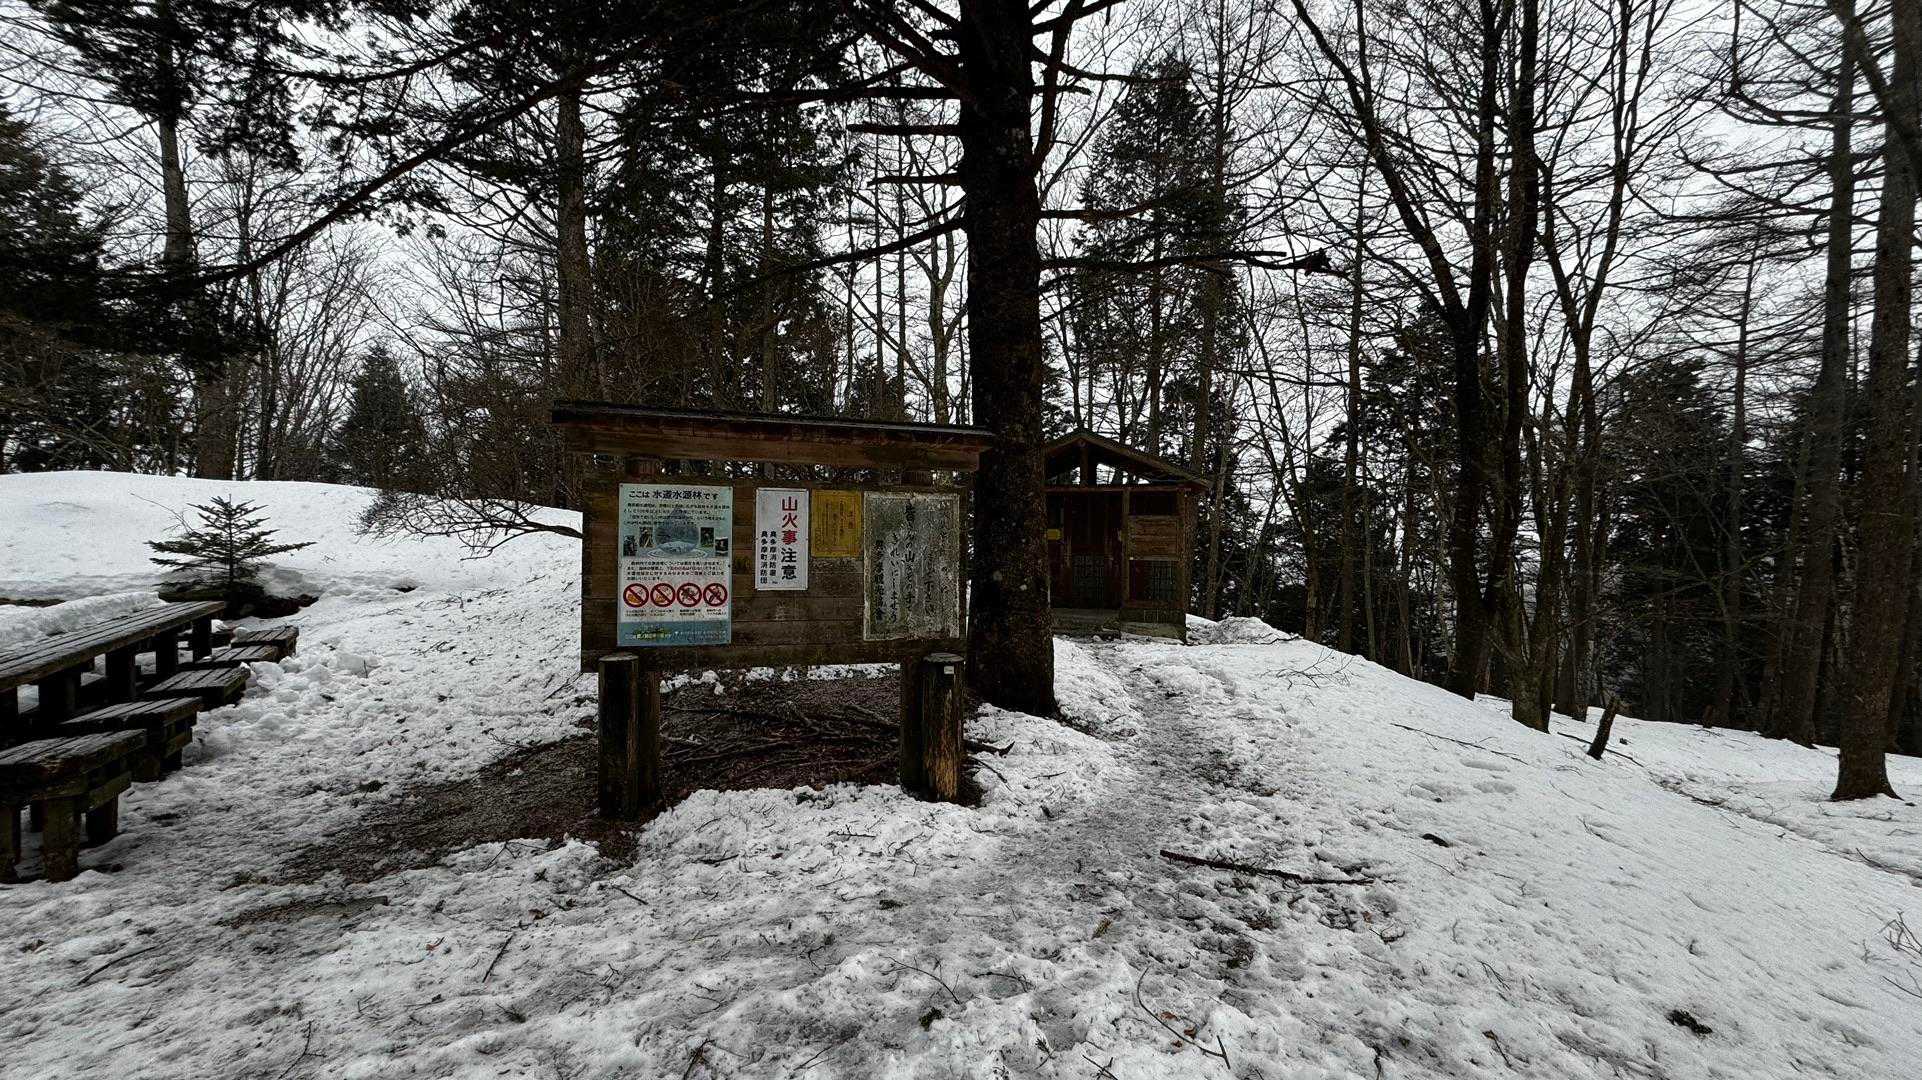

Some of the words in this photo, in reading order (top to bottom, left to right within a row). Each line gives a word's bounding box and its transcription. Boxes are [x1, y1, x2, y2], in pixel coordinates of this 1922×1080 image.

[781, 496, 798, 580] 山火事注意
